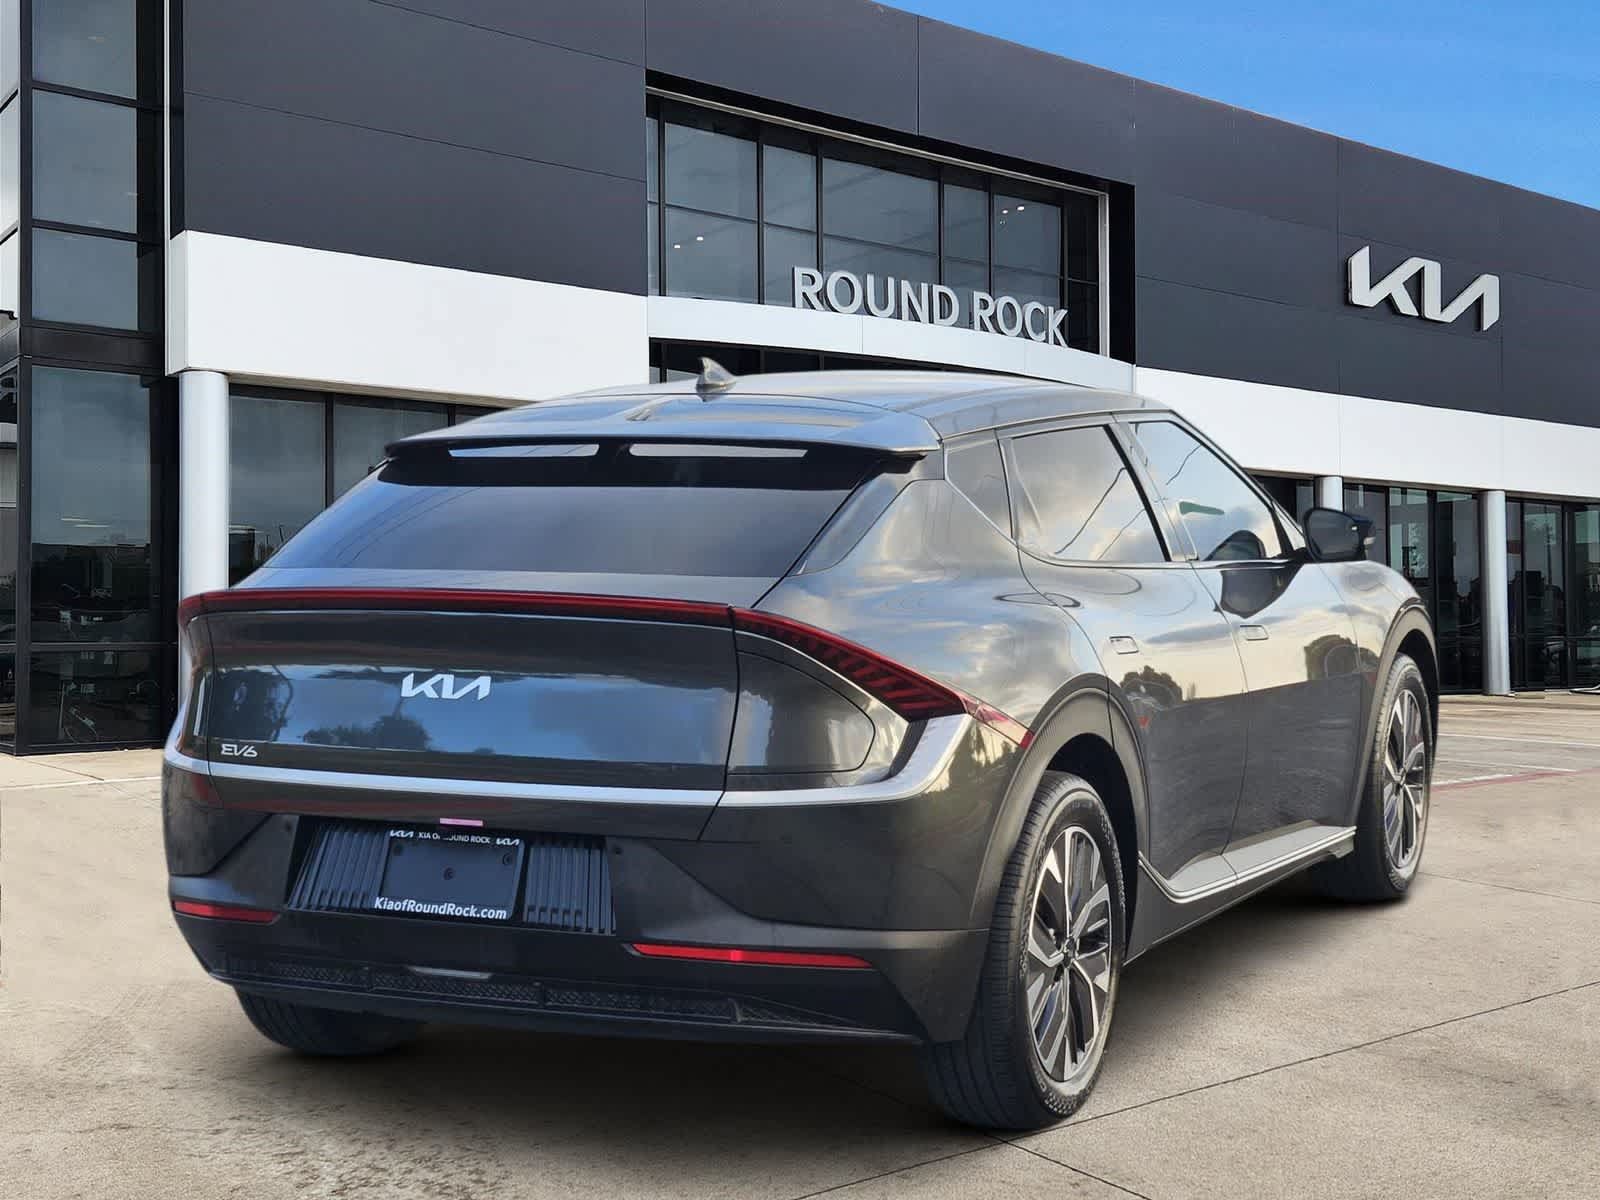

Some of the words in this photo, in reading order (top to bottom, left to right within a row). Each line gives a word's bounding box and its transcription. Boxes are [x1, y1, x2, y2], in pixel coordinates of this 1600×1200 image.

[1347, 245, 1500, 331] KIA
[792, 265, 960, 326] ROUND
[971, 290, 1069, 348] ROCK
[401, 672, 491, 700] KIA
[220, 743, 258, 758] EV6
[470, 835, 491, 844] ROCK
[374, 896, 507, 919] KiaofRoundRock.com
